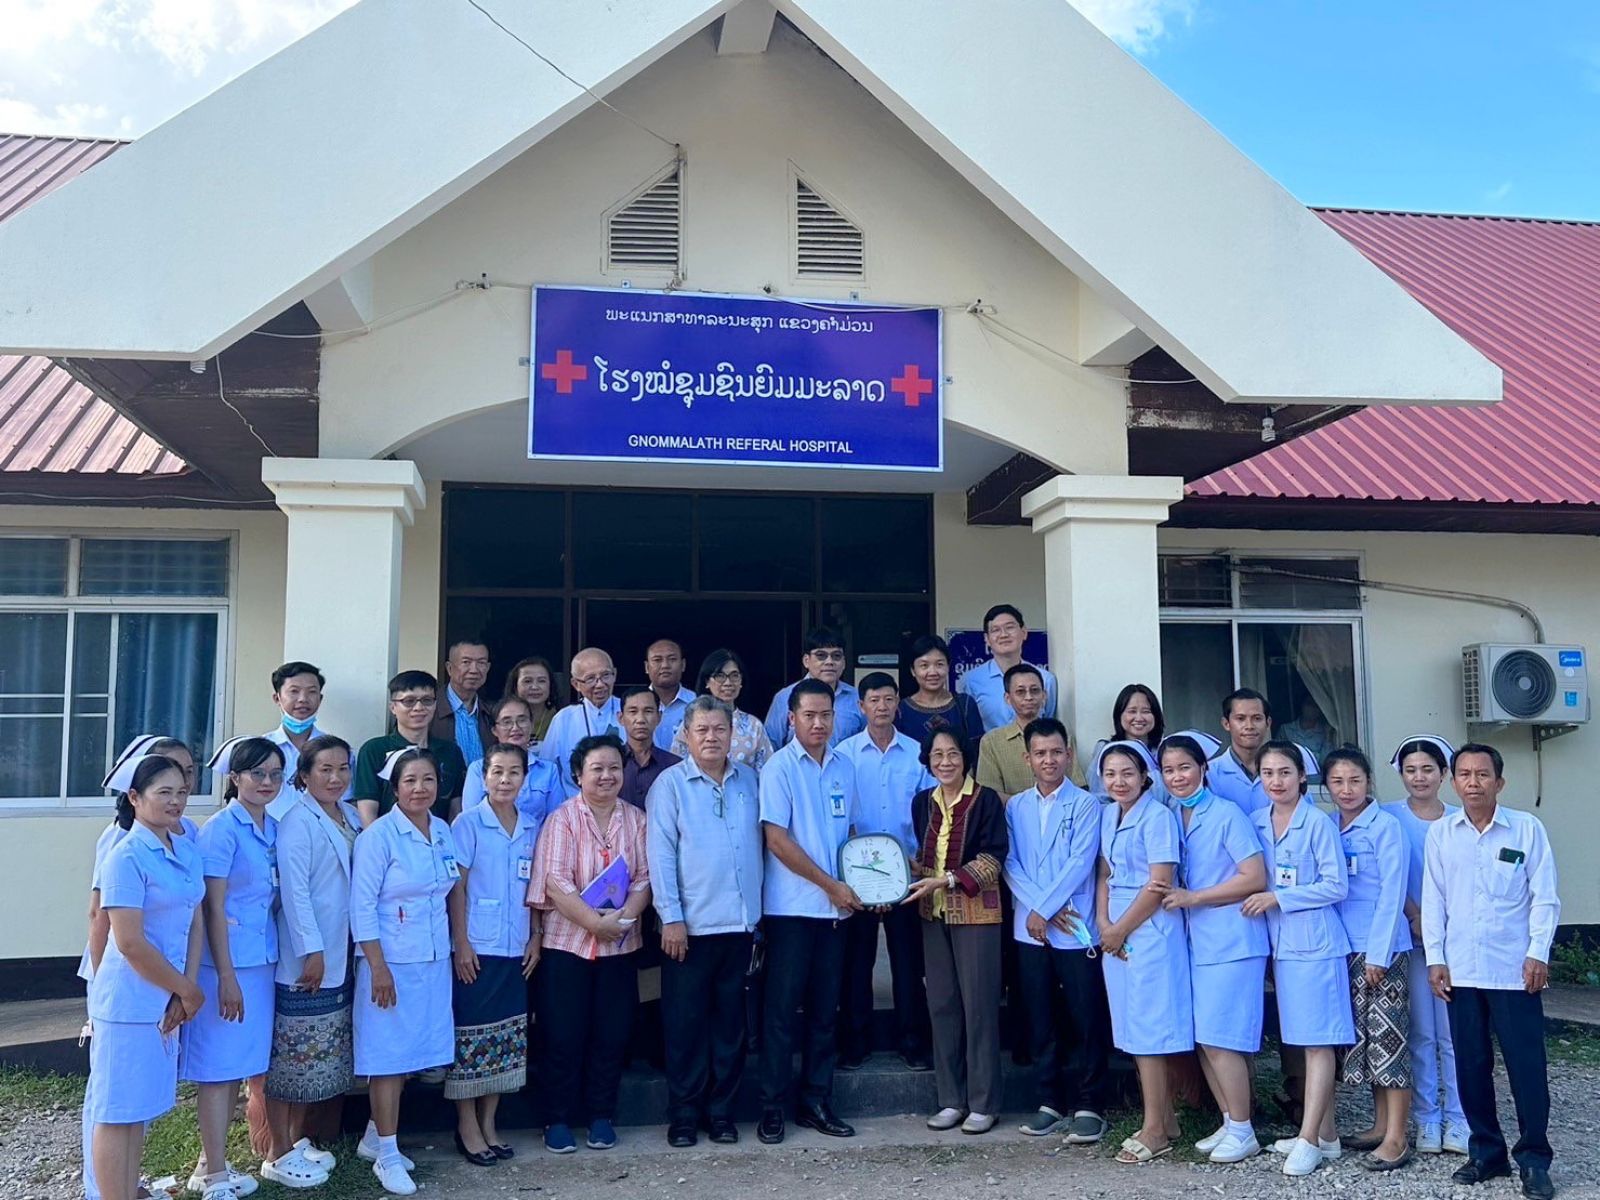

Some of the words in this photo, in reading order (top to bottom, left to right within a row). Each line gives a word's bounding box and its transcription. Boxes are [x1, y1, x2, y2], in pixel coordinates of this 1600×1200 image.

[628, 434, 723, 449] GNOMMALATH
[726, 437, 786, 451] REFERAL
[790, 440, 853, 454] HOSPITAL
